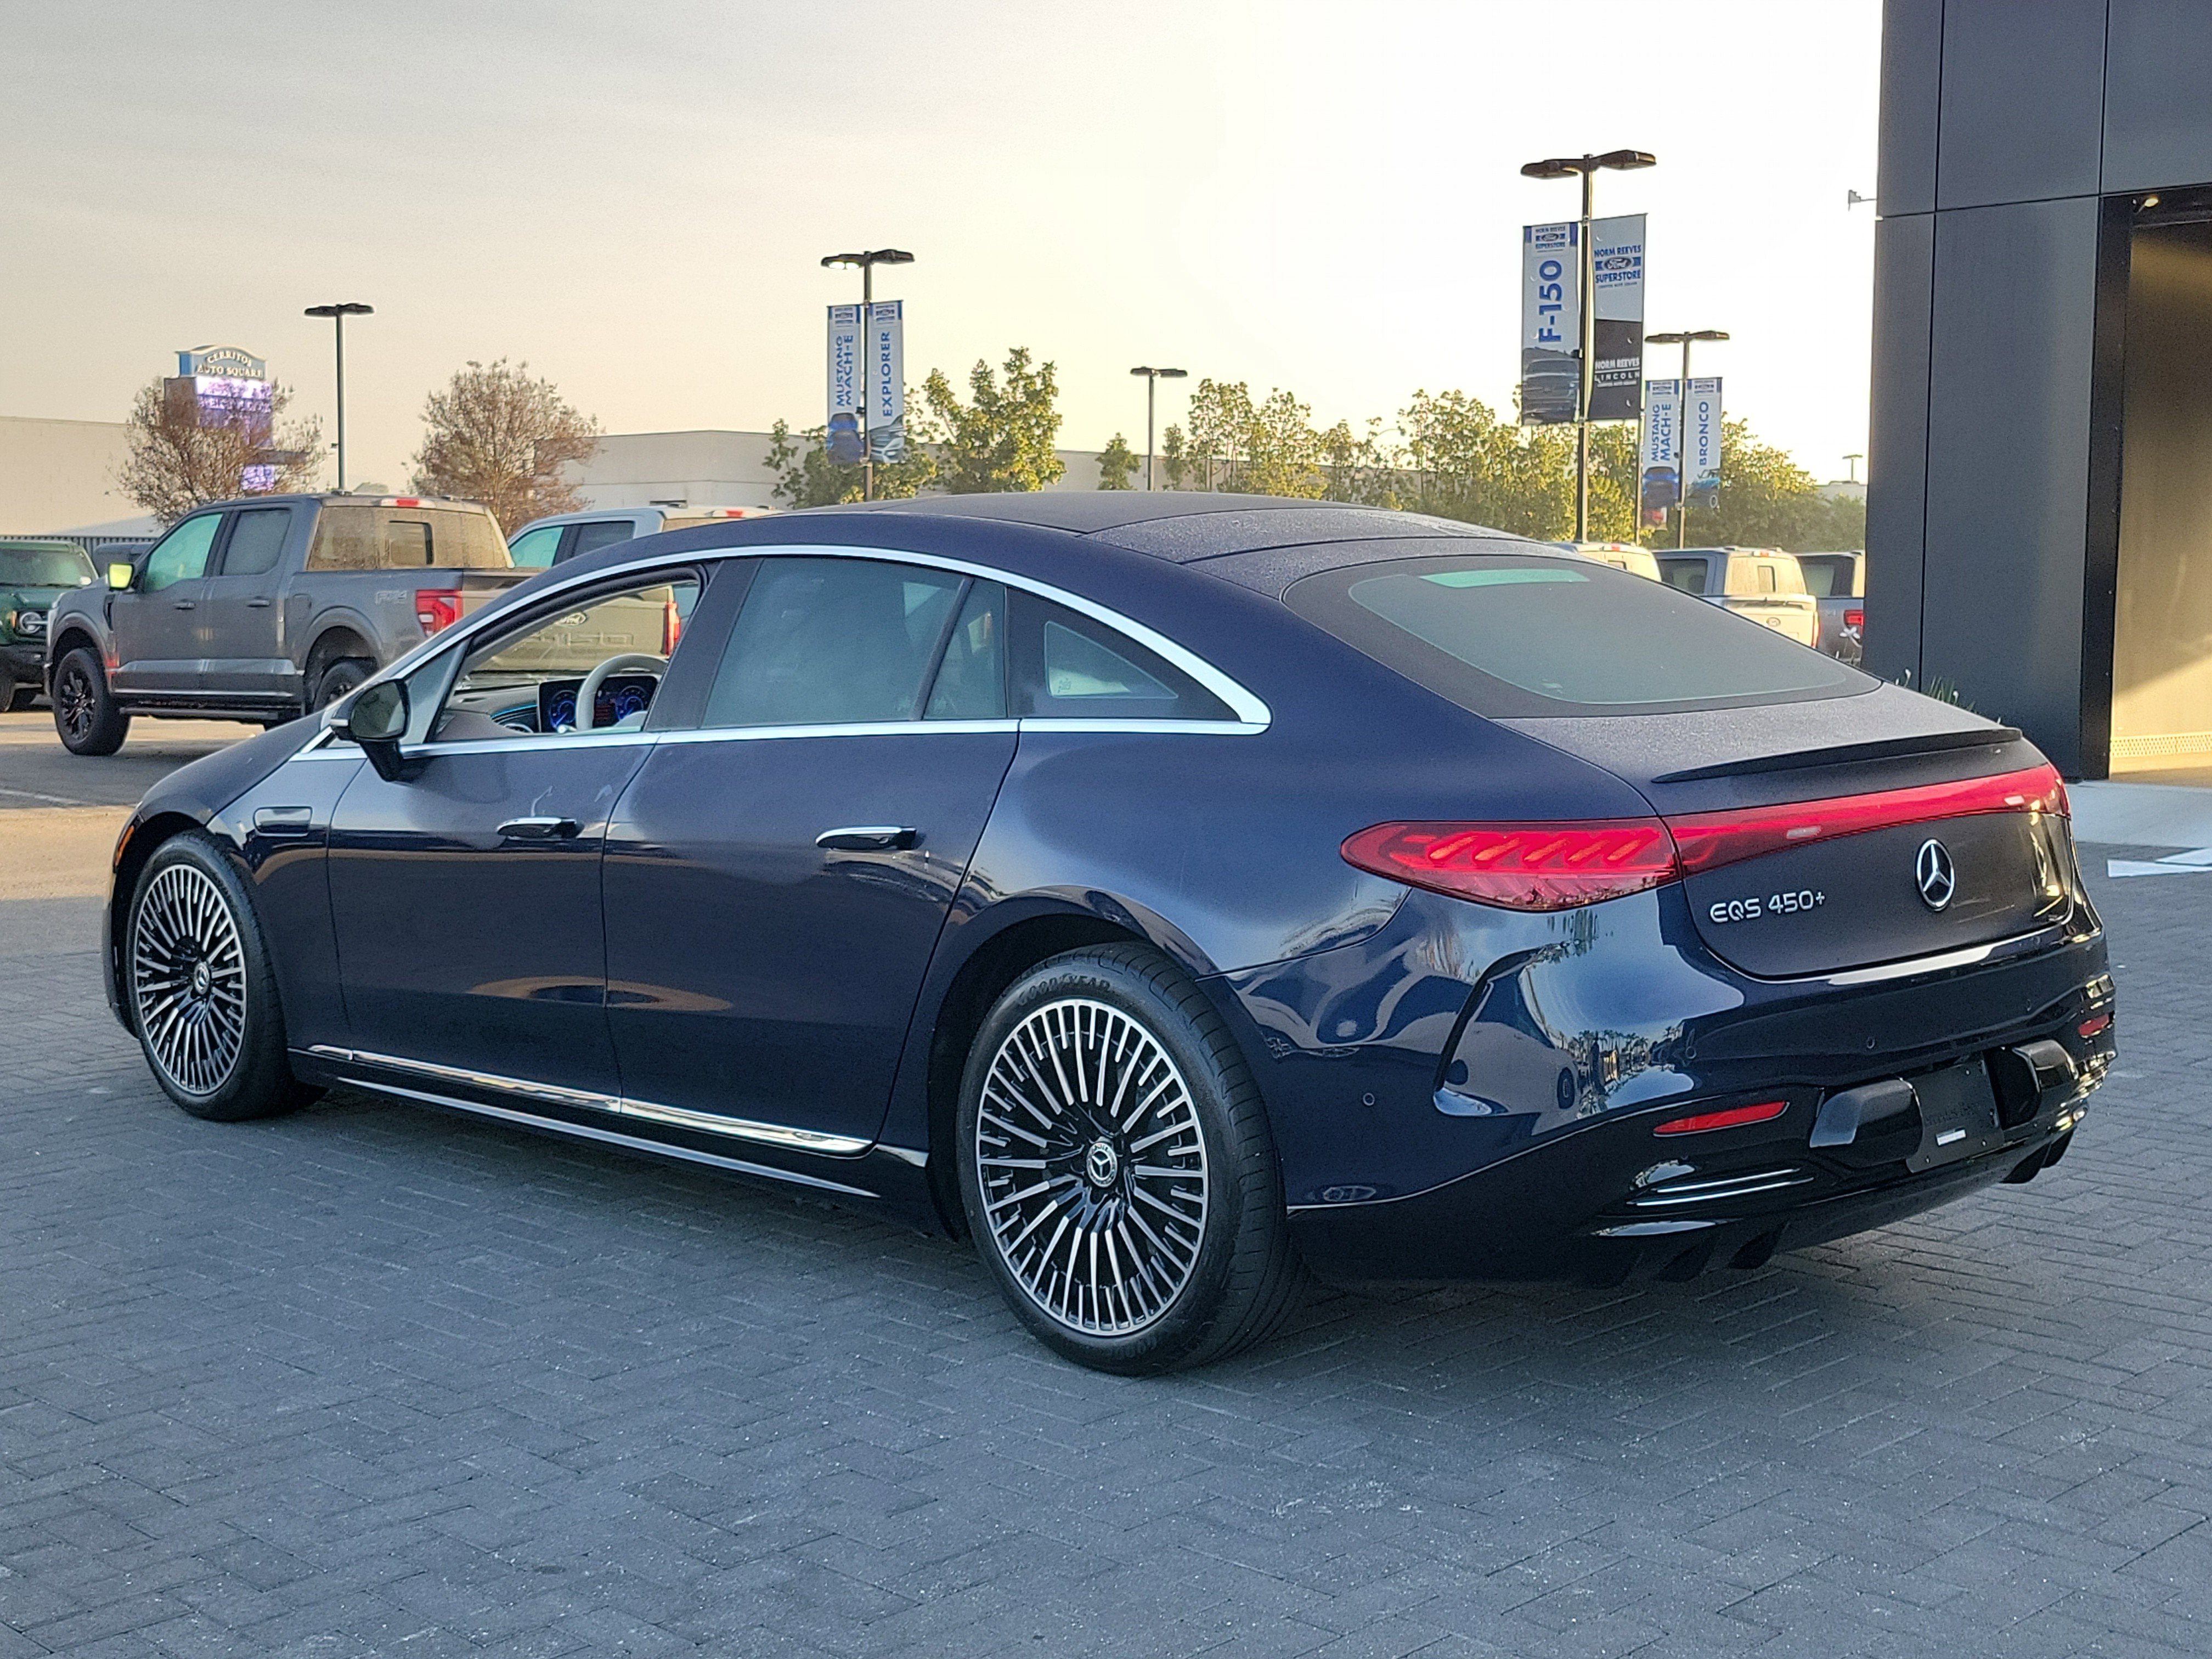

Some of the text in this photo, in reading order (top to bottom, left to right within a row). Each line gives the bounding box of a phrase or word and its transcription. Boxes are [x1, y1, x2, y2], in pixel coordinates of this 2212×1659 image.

[1594, 244, 1641, 257] NORM REEVES
[1595, 269, 1641, 283] SUPERSTORE
[1538, 260, 1562, 342] F-150
[196, 364, 262, 376] AUTO SQUARE
[207, 351, 252, 367] CERRITOS
[844, 335, 853, 406] MACH-E
[881, 331, 893, 417] EXPLORER
[1595, 357, 1639, 370] NORM REEVES
[1594, 371, 1640, 383] LINCOLN
[1651, 404, 1660, 461] MUSTANG
[1660, 403, 1671, 461] MACH-E
[1699, 401, 1709, 465] BRONCO
[1710, 890, 1825, 923] EQS 450+
